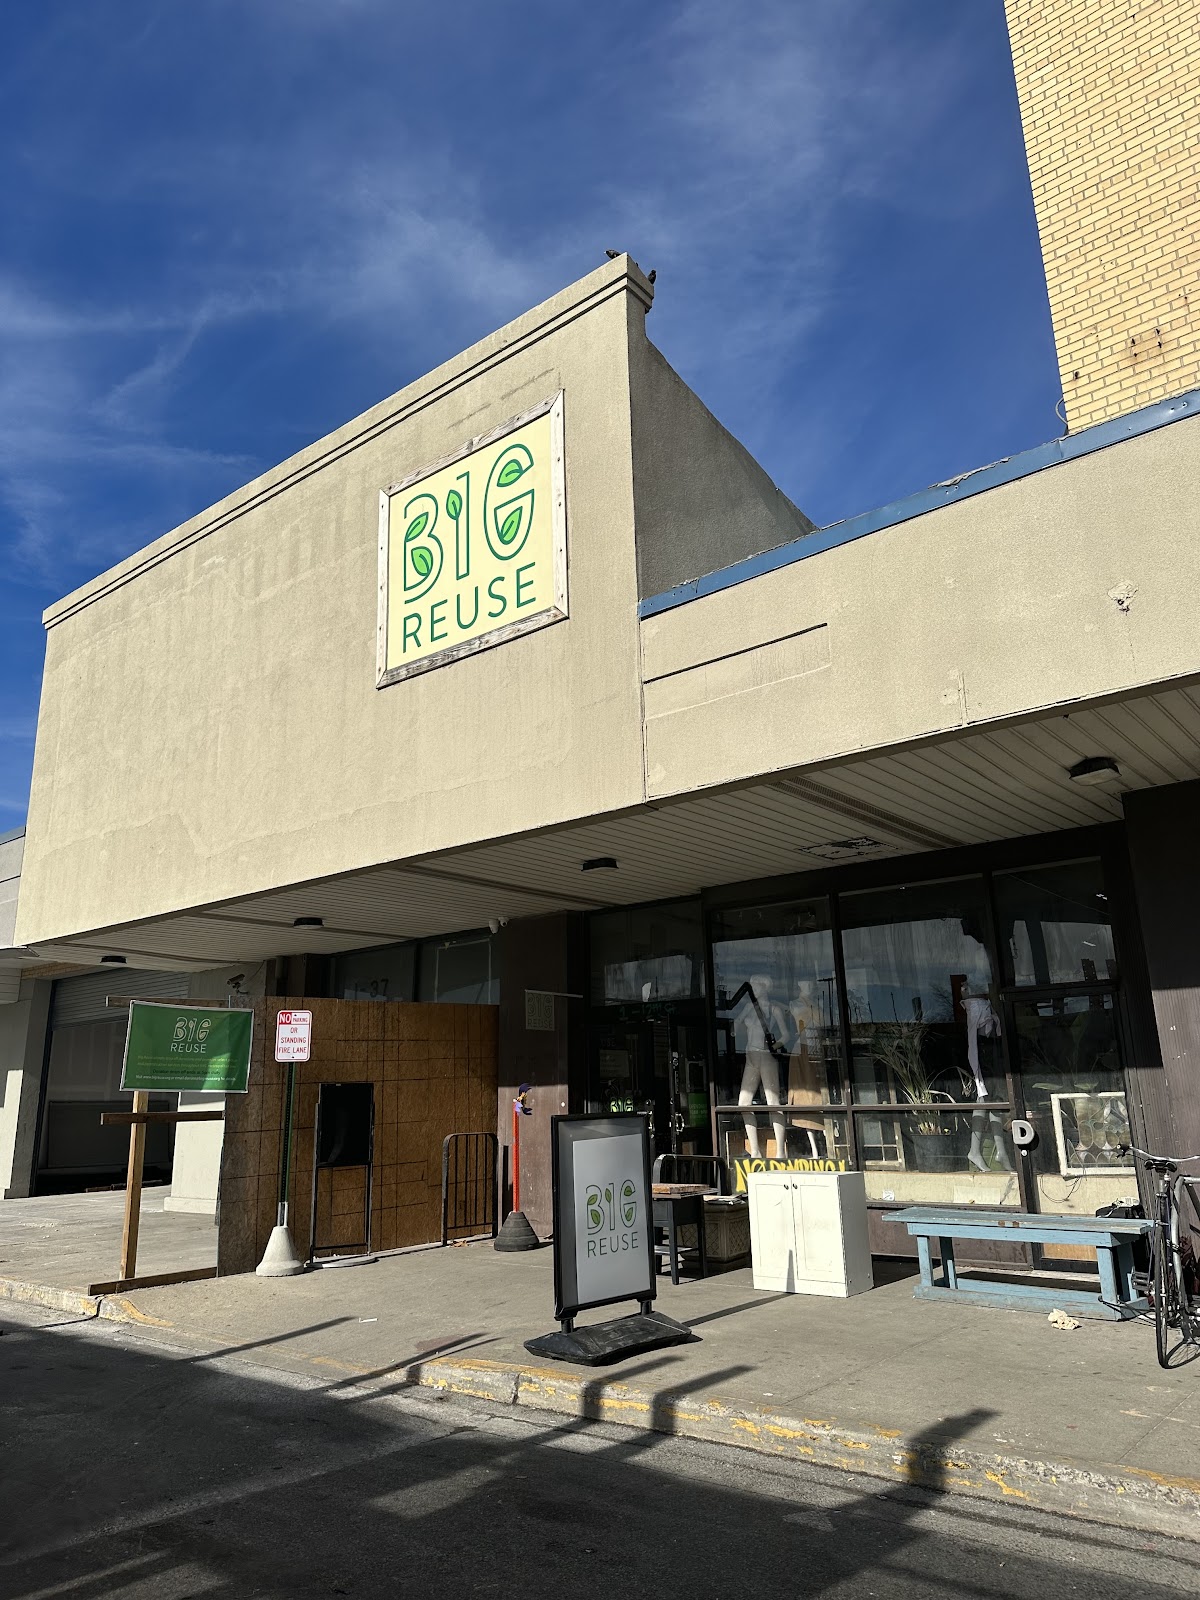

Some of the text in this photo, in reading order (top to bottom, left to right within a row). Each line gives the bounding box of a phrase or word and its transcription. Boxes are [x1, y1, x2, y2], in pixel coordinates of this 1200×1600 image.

[403, 443, 535, 605] BIG
[403, 561, 537, 654] REUSE
[528, 993, 552, 1018] BIG
[173, 1016, 212, 1043] BIG
[279, 1013, 292, 1024] NO
[290, 1026, 298, 1034] OR
[528, 1018, 552, 1029] REUSE
[170, 1043, 207, 1054] REUSE
[278, 1046, 307, 1054] FIRE LANE
[280, 1036, 307, 1044] STANDING
[1011, 1119, 1035, 1145] D
[585, 1179, 638, 1235] BIG
[587, 1231, 639, 1258] REUSE
